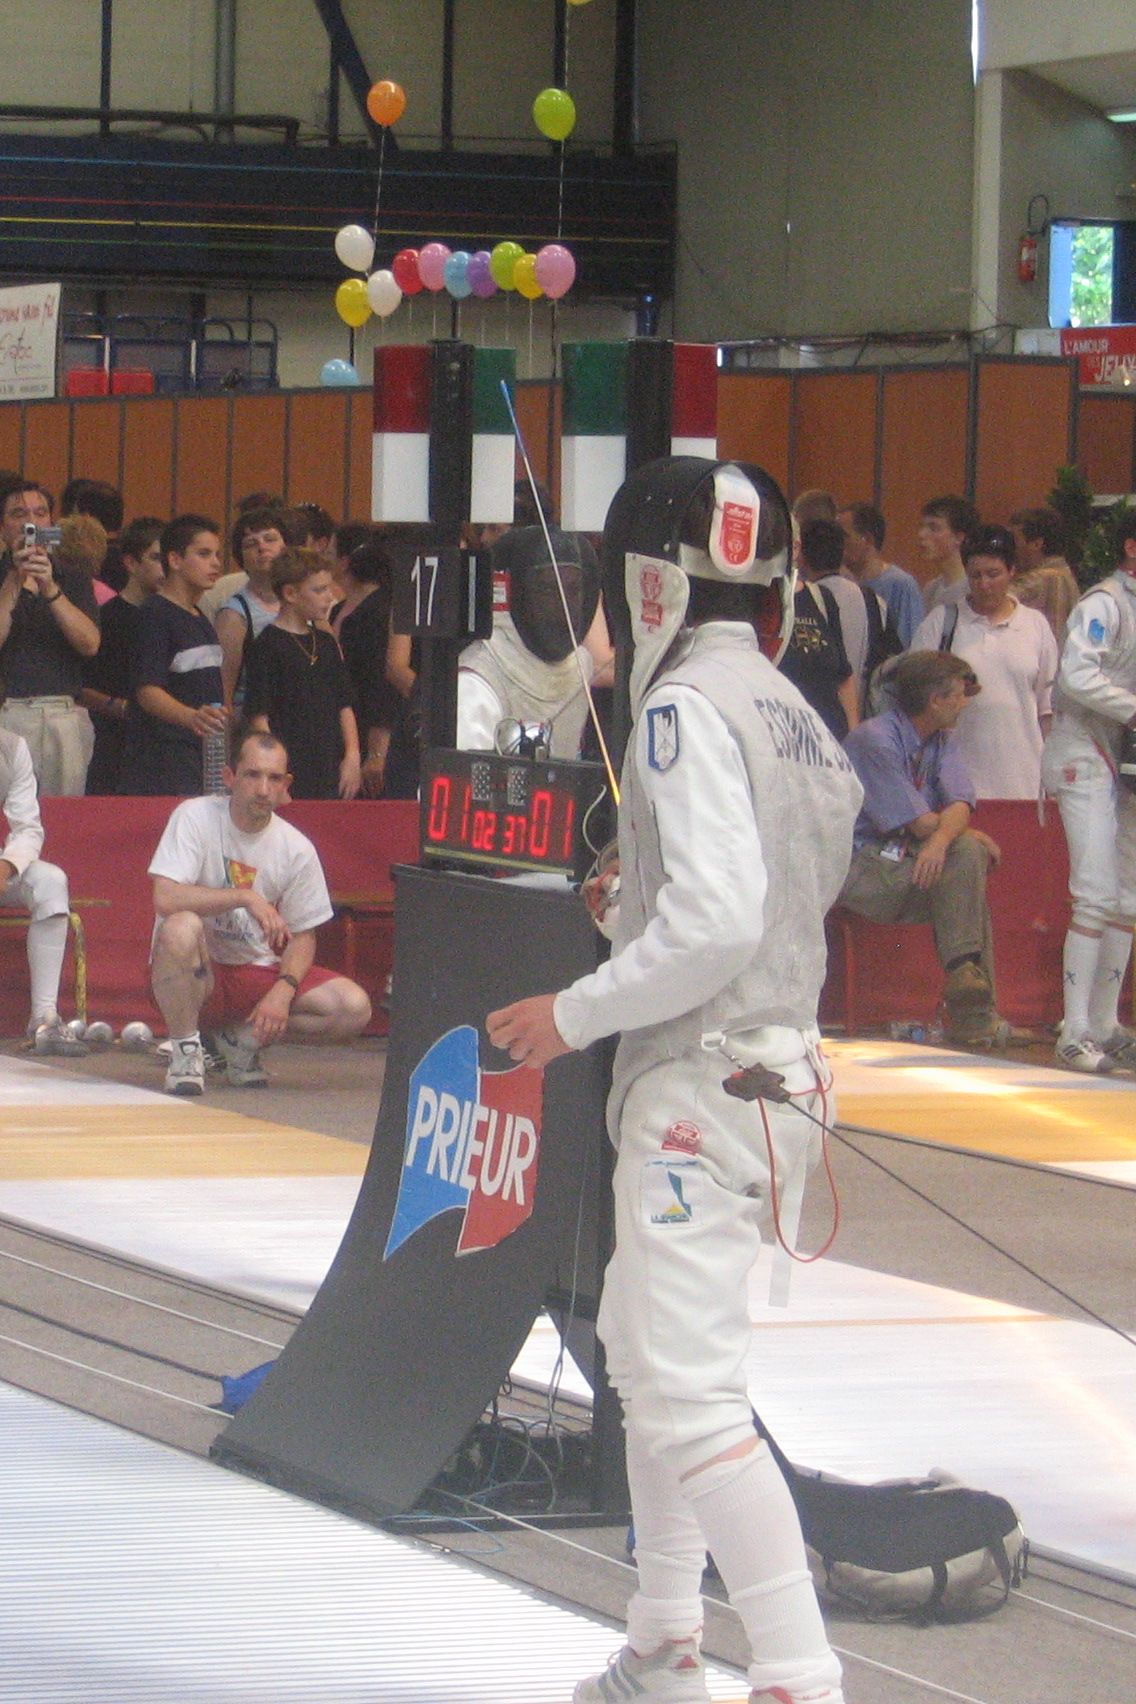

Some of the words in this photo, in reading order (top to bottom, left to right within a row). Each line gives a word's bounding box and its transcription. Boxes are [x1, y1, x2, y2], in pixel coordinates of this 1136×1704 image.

[1064, 339, 1109, 354] L'AMOUR
[411, 556, 438, 626] 17
[428, 775, 473, 842] 01
[472, 810, 497, 851] 02
[502, 815, 527, 854] 37
[529, 790, 575, 859] 01
[406, 1085, 538, 1206] PRIEUR
